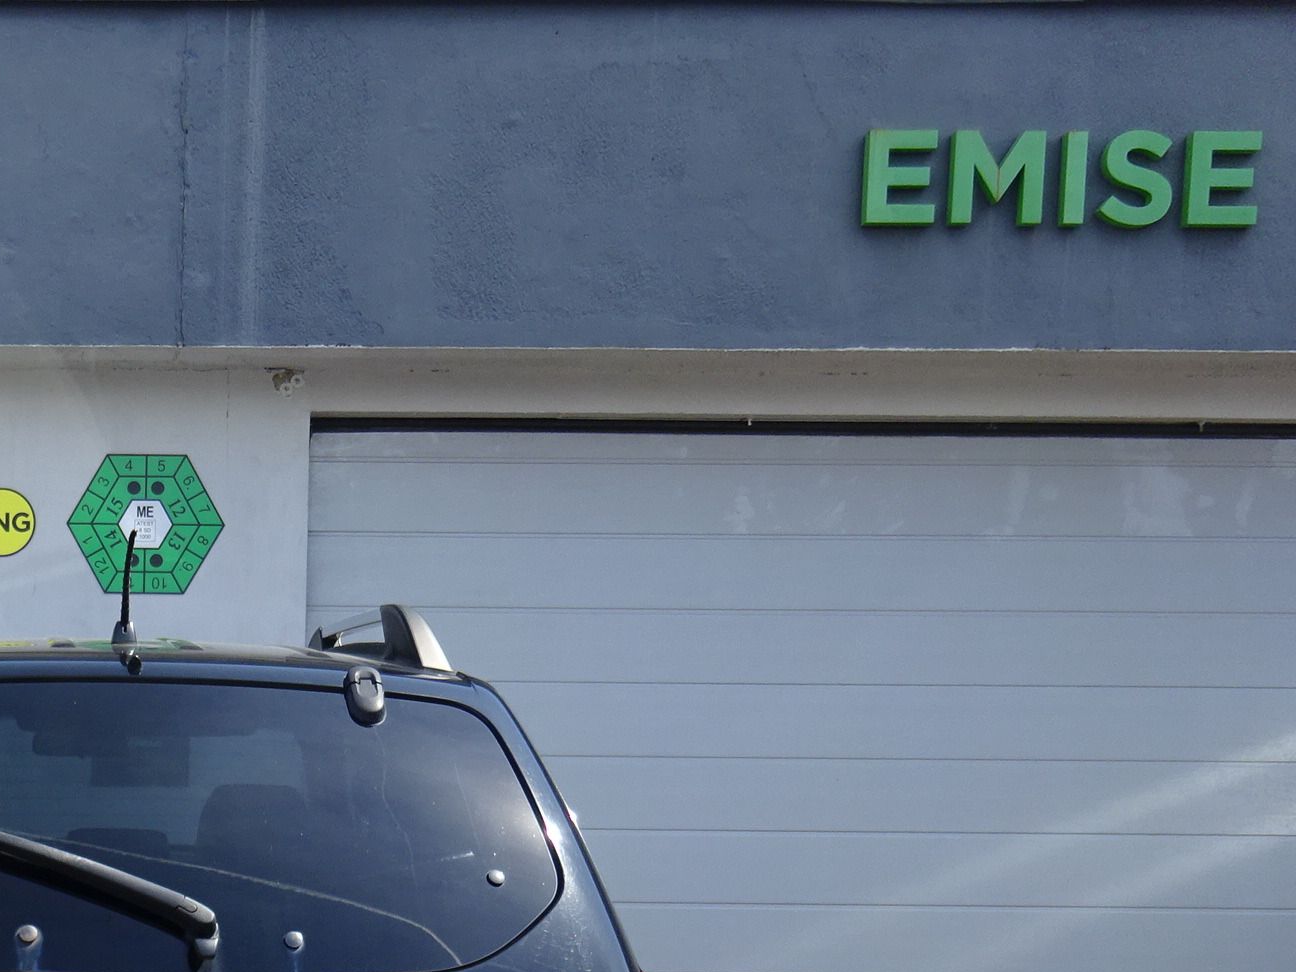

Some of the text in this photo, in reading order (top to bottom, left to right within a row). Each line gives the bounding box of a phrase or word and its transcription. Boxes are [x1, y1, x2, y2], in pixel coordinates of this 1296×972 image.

[861, 129, 1264, 229] EMISE
[124, 460, 133, 472] 4
[157, 460, 166, 472] 5
[97, 476, 110, 487] 3
[81, 504, 94, 515] 2
[106, 497, 124, 517] 15
[136, 505, 154, 518] ME
[168, 499, 186, 518] 12
[199, 504, 211, 514] 7
[82, 535, 94, 545] 1
[104, 529, 123, 549] 14
[168, 532, 186, 550] 13
[197, 535, 209, 546] 8
[94, 557, 110, 575] 12
[151, 577, 167, 590] 10
